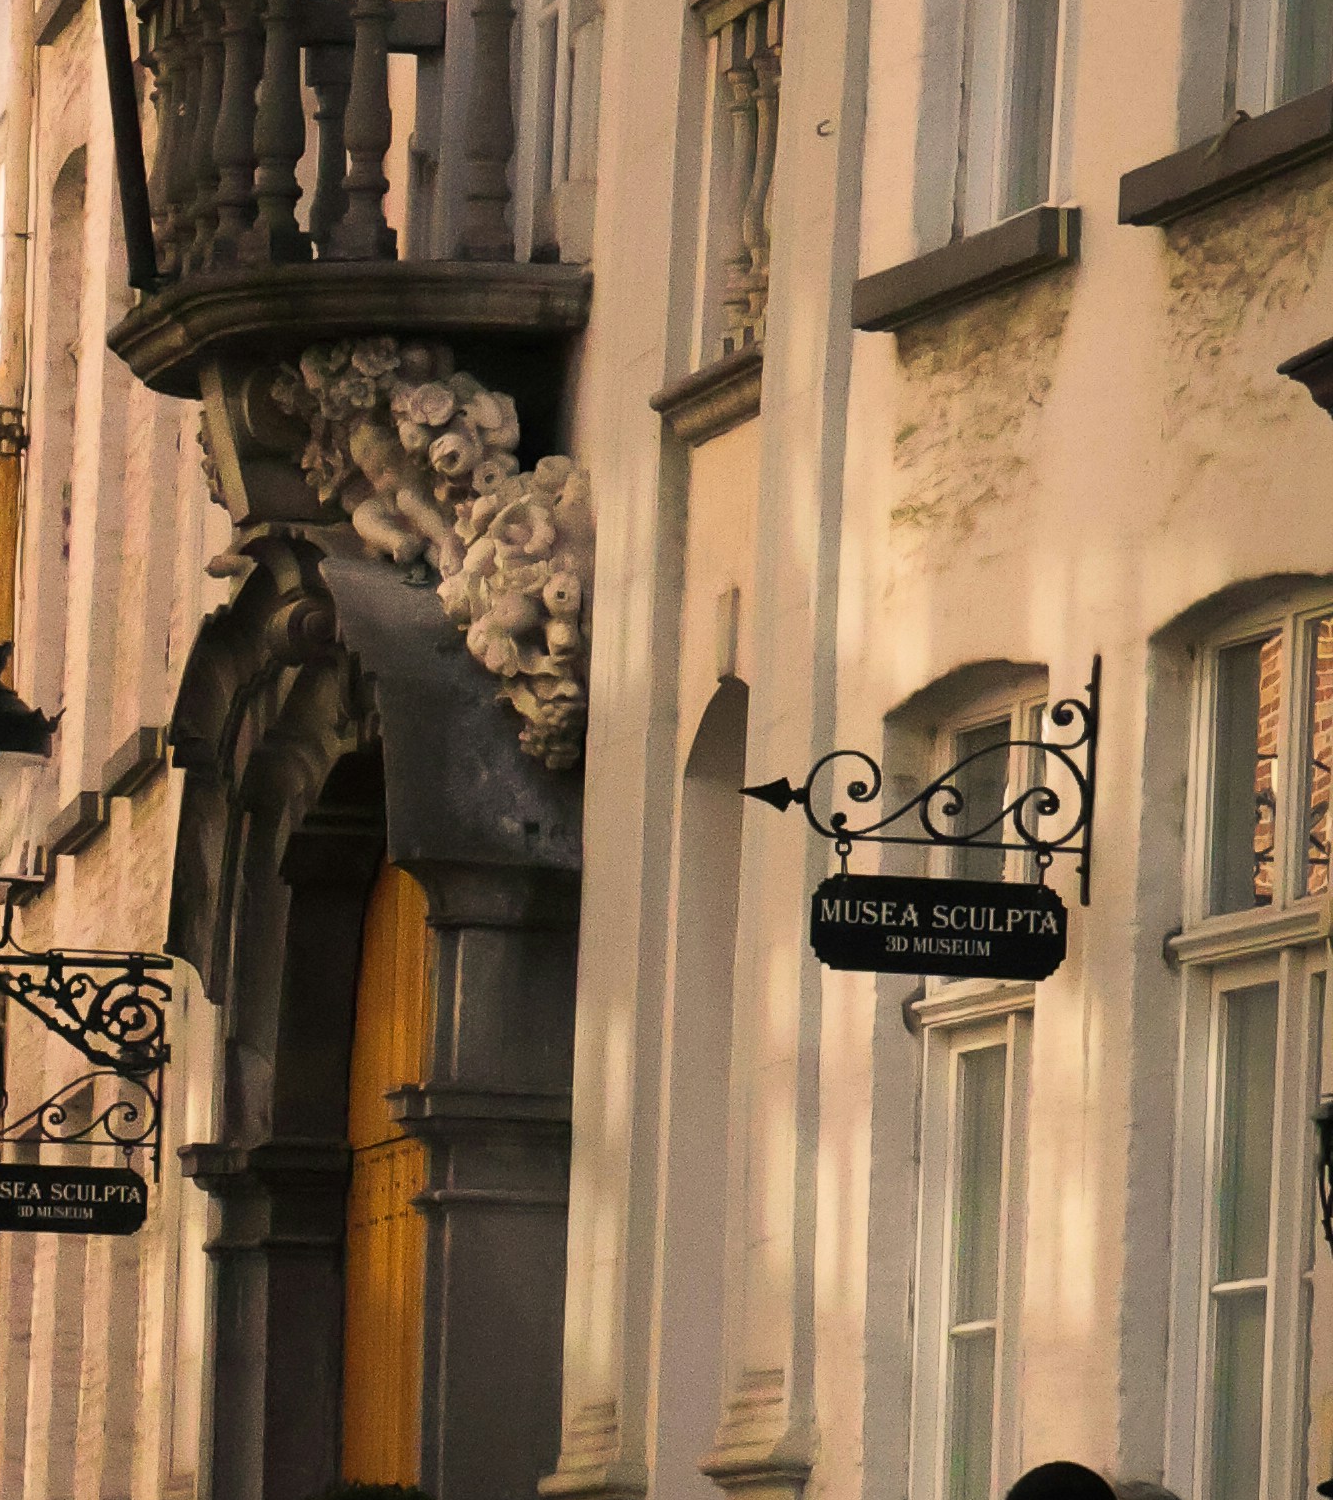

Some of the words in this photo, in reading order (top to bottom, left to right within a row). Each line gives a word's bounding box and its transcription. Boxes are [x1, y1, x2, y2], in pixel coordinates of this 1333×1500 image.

[820, 898, 919, 927] MUSEA
[931, 904, 1059, 935] SCULPTA
[885, 935, 908, 952] 3D
[913, 938, 991, 957] MUSEUM
[50, 1183, 141, 1204] SCULPTA
[36, 1206, 94, 1219] MUSEUM
